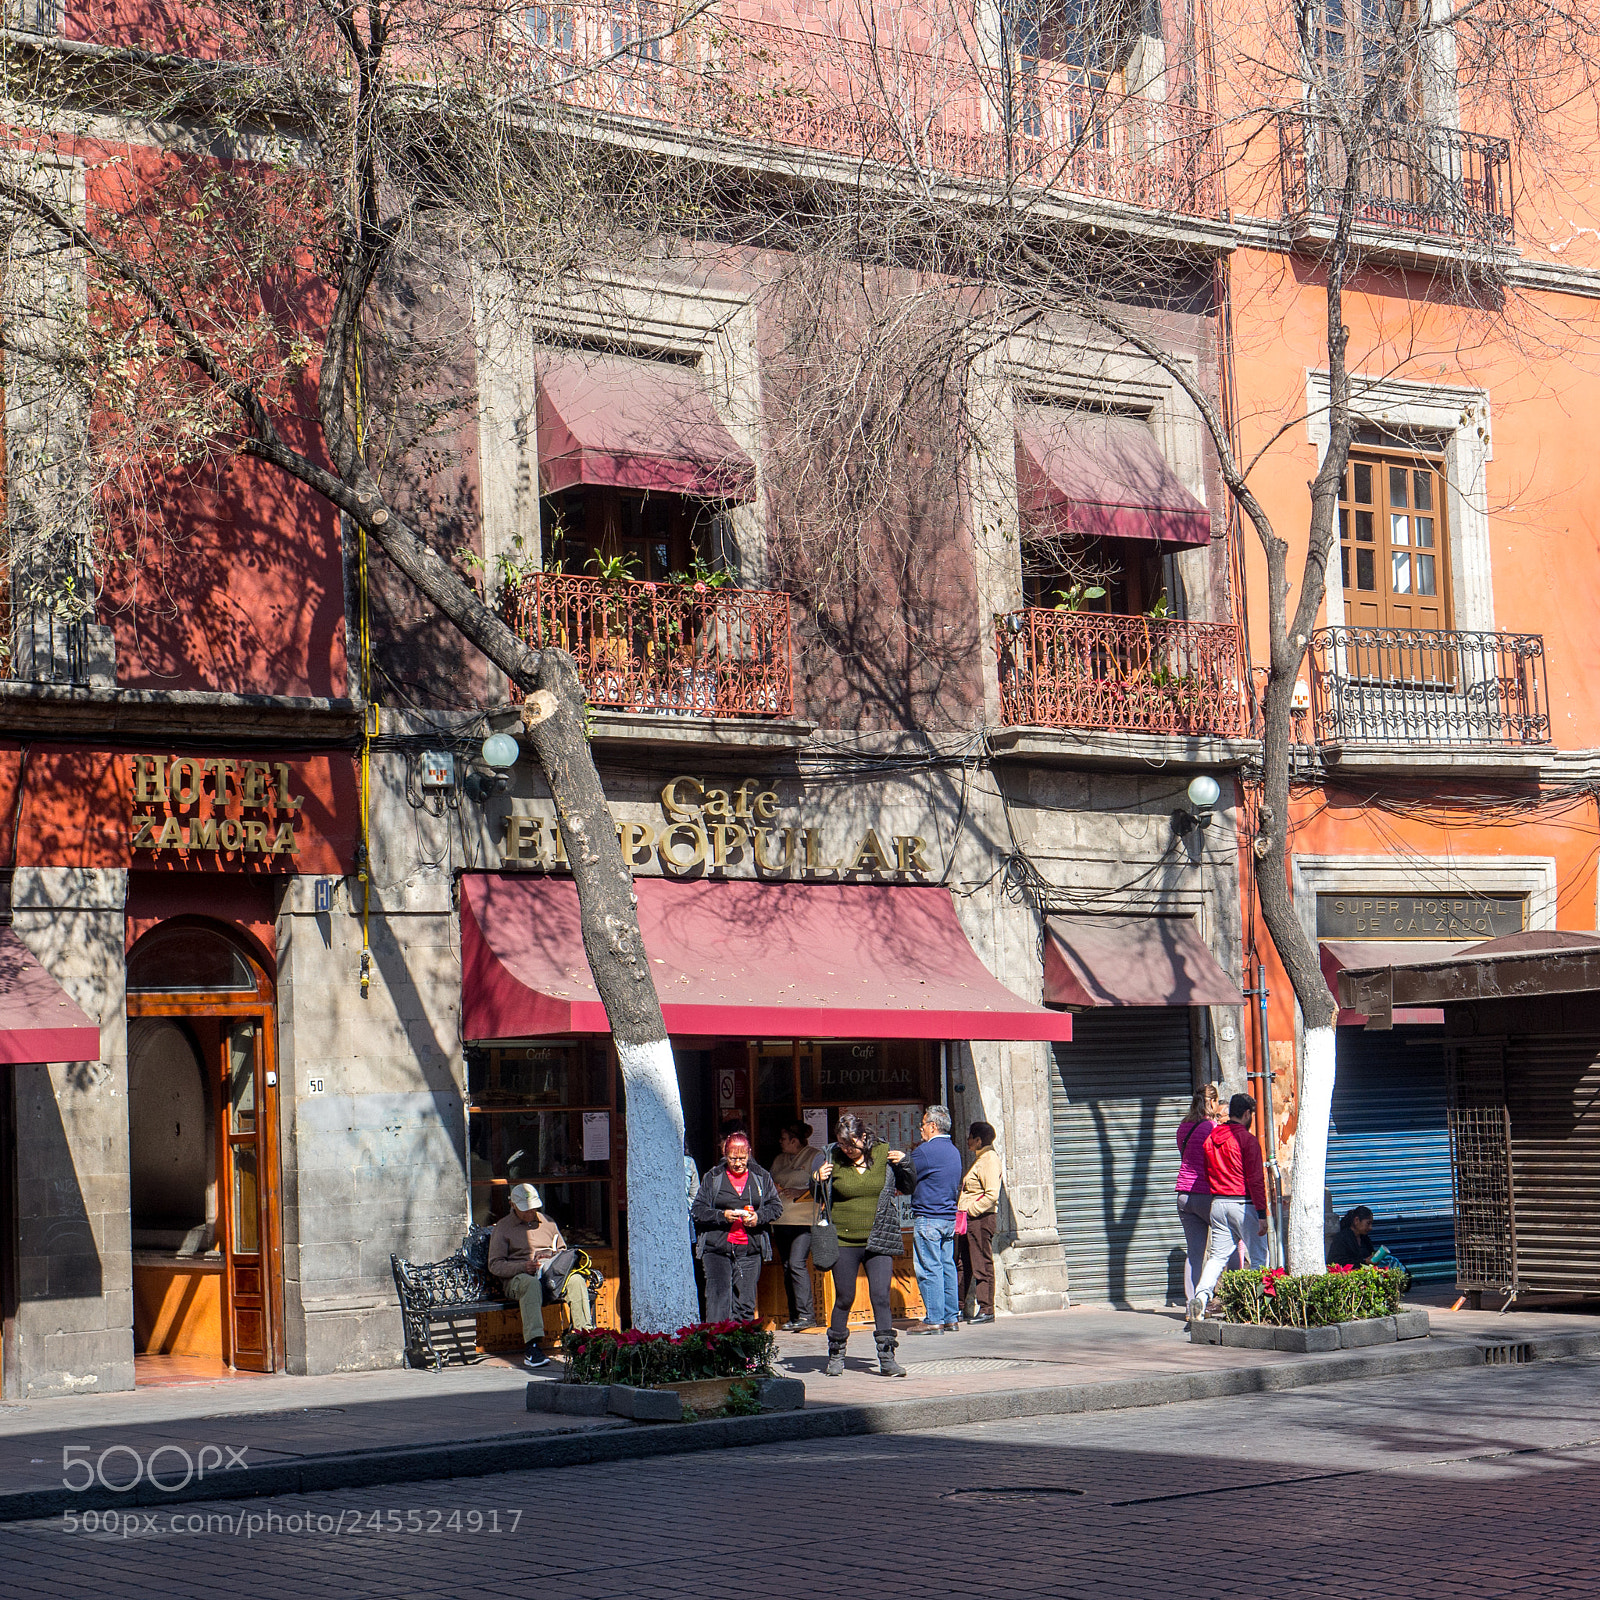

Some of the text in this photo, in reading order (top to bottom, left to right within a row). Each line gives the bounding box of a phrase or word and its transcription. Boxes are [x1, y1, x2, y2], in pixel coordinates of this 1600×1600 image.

[131, 755, 304, 809] HOTEL
[661, 775, 783, 818] Café
[131, 816, 301, 854] ZAMORA
[617, 821, 935, 873] POPULAR
[1334, 901, 1507, 916] SUPER HOSPITAL
[1355, 918, 1488, 932] DE CALZADO
[525, 1047, 551, 1061] Café
[851, 1045, 875, 1058] Café
[817, 1068, 913, 1085] EL POPULAR
[310, 1080, 323, 1092] 50
